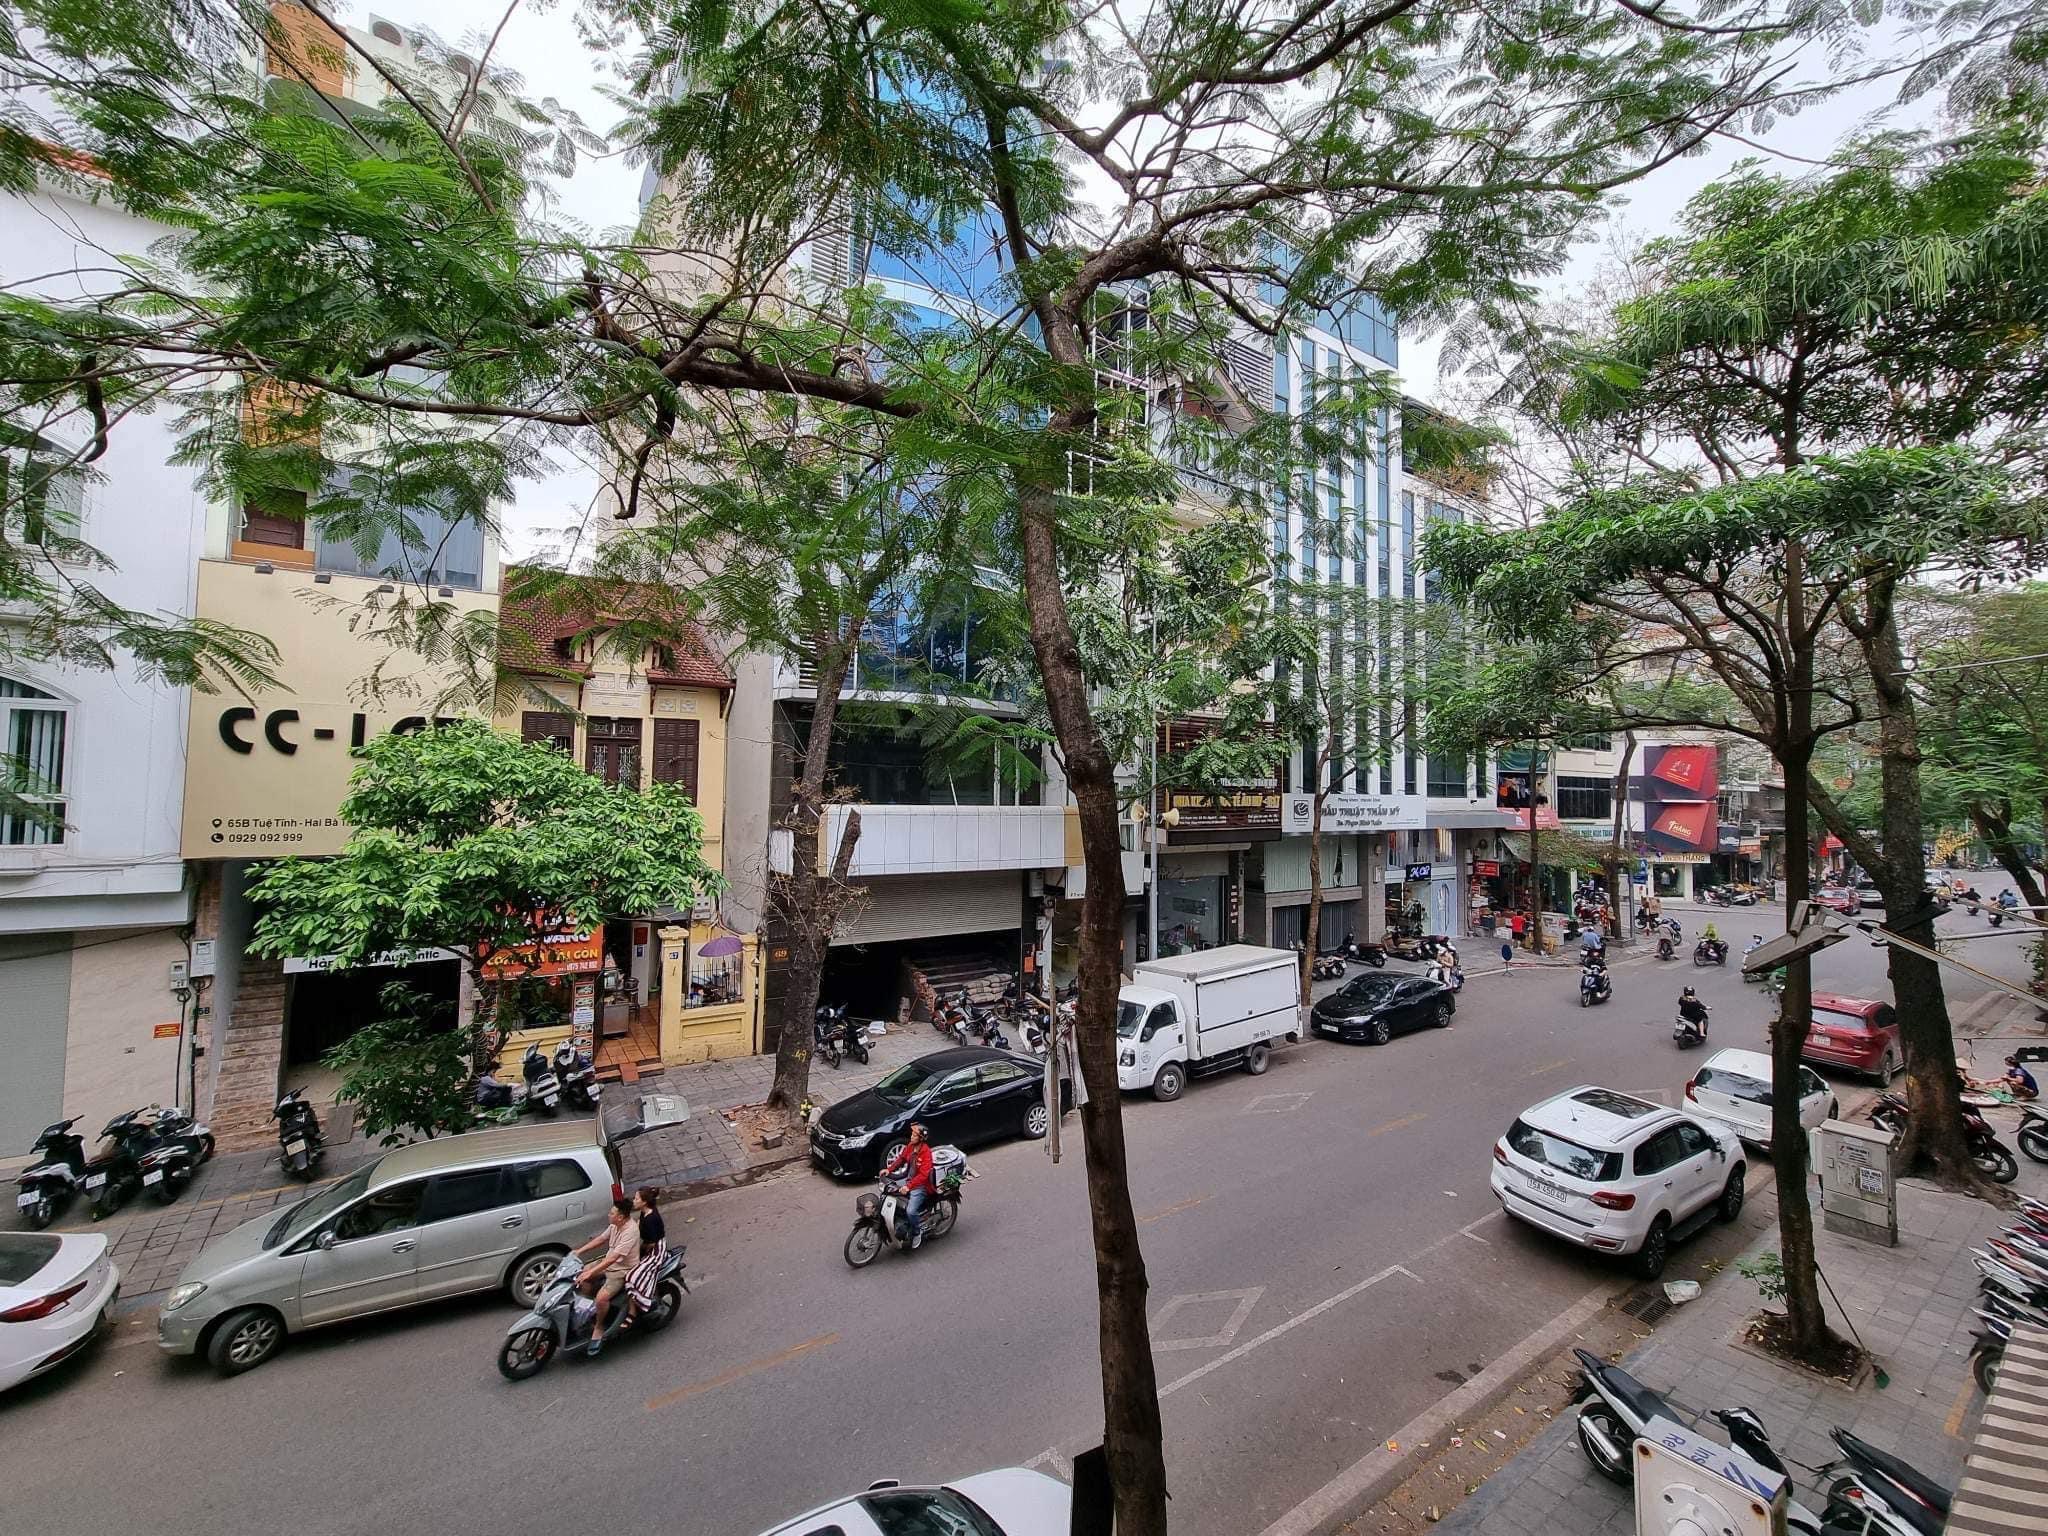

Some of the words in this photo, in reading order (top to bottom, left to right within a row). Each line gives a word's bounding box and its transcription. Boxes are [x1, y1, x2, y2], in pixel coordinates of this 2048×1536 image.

[227, 818, 250, 828] 65B
[252, 818, 272, 829] Tuệ
[304, 818, 322, 827] Hai
[228, 833, 256, 843] 0929
[260, 833, 280, 842] 092
[283, 833, 303, 842] 999
[573, 946, 598, 959] GÒN
